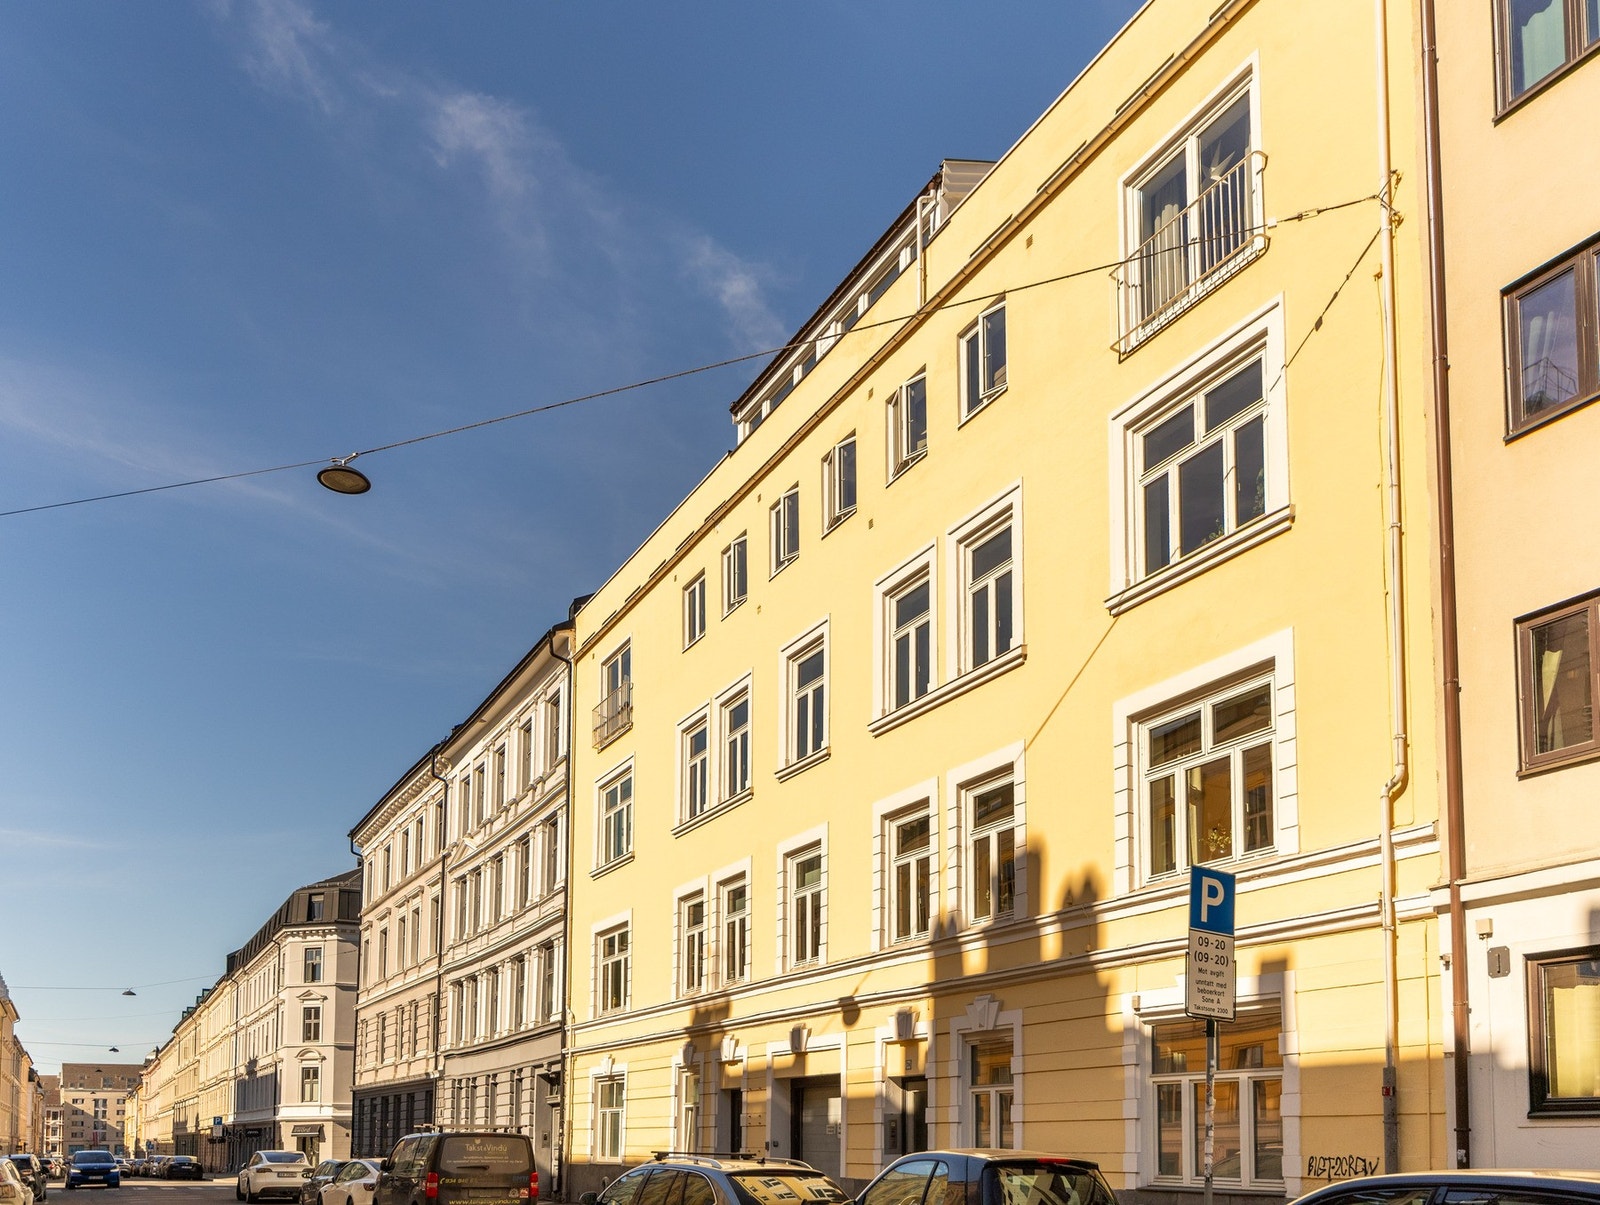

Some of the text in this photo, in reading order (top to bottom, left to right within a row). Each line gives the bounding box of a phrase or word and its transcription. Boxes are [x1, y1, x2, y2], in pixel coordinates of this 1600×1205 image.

[1201, 876, 1224, 922] P
[1198, 967, 1225, 979] Mot avgift
[1195, 979, 1214, 987] unntatt
[1197, 986, 1225, 997] beboerkort
[1202, 995, 1214, 1004] Sone
[214, 1117, 221, 1125] P
